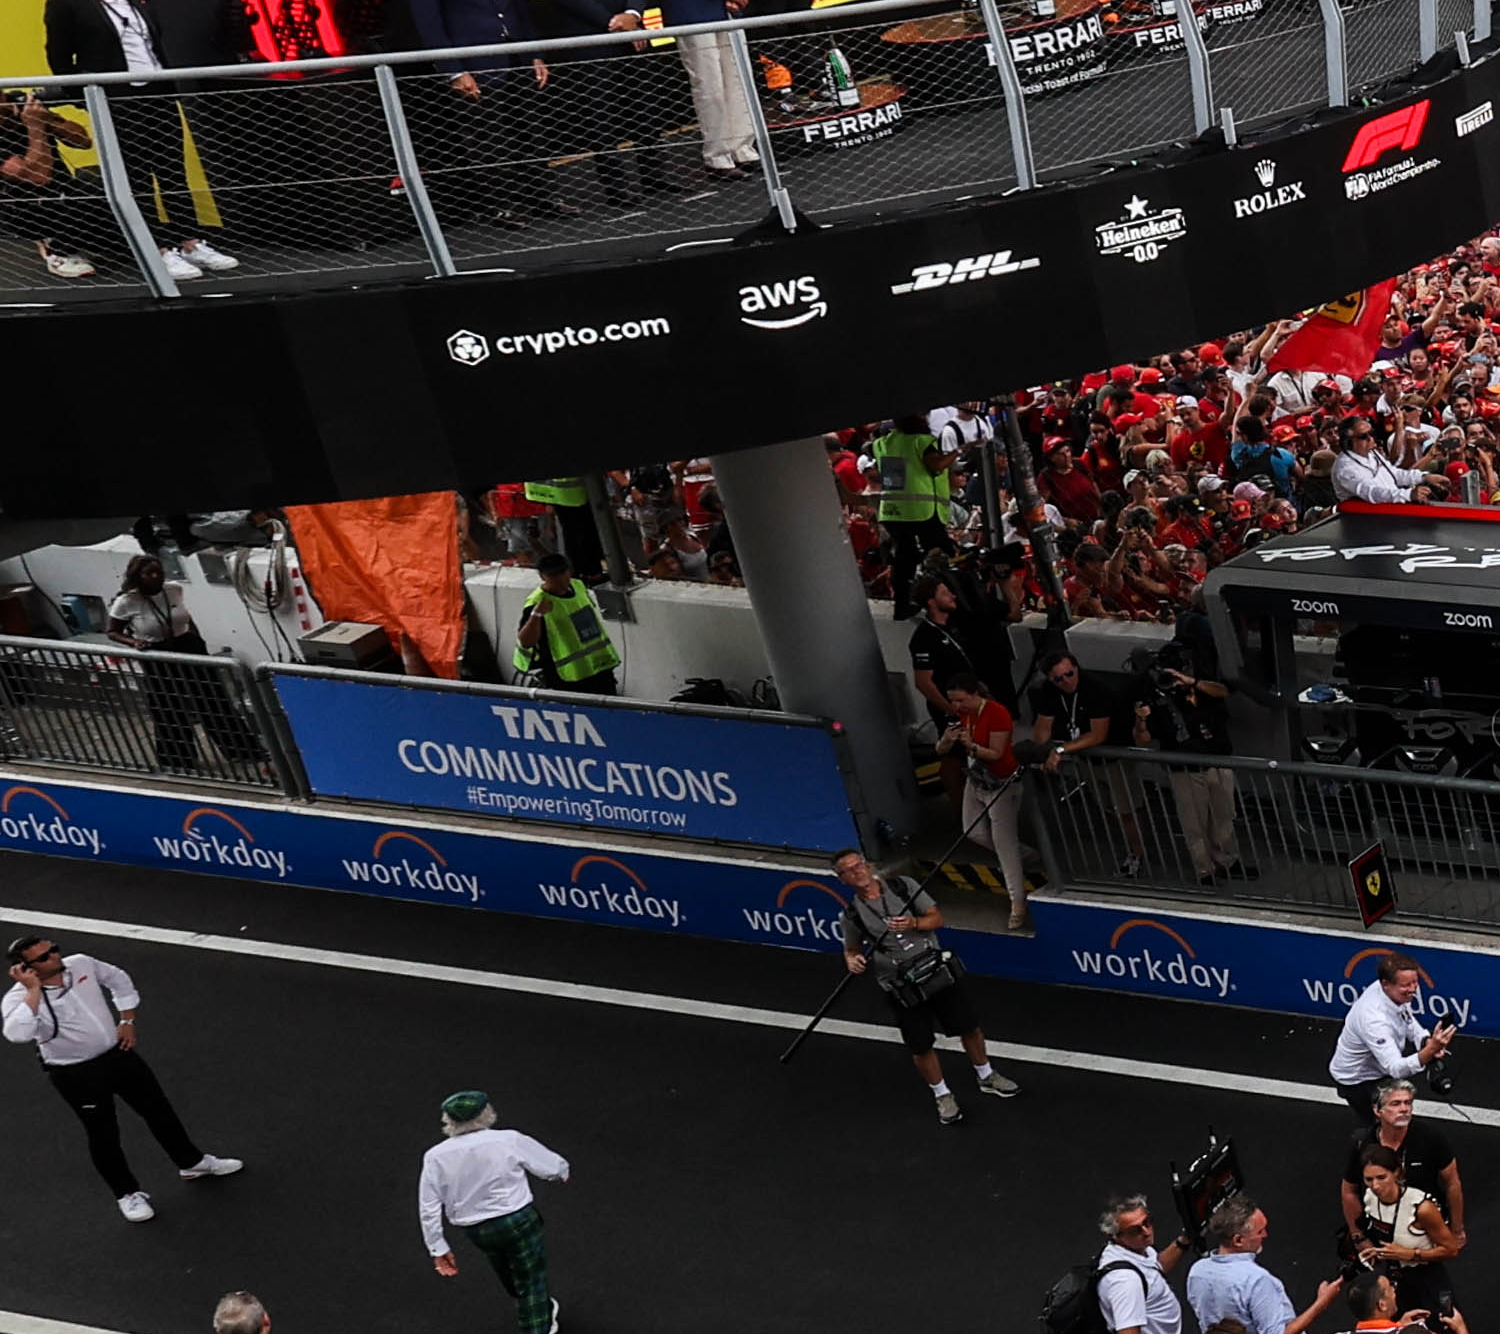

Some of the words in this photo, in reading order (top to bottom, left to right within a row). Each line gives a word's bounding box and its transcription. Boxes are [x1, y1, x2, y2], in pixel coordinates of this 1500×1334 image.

[1025, 56, 1075, 76] TRENTO
[802, 101, 902, 143] FERRARI
[1455, 100, 1494, 138] PIRELLI
[833, 133, 874, 149] TRENTO
[1233, 181, 1307, 219] ROLEX
[1101, 212, 1182, 245] Heineken
[911, 250, 1021, 292] DHL
[739, 276, 820, 313] aws
[495, 316, 672, 357] crypto.com
[1291, 599, 1340, 615] zoom
[1443, 612, 1493, 629] zoom
[491, 705, 607, 749] TATA
[397, 738, 738, 809] COMMUNICATIONS
[466, 784, 687, 829] #EmpoweringTomorrow
[0, 815, 106, 855] orkday.
